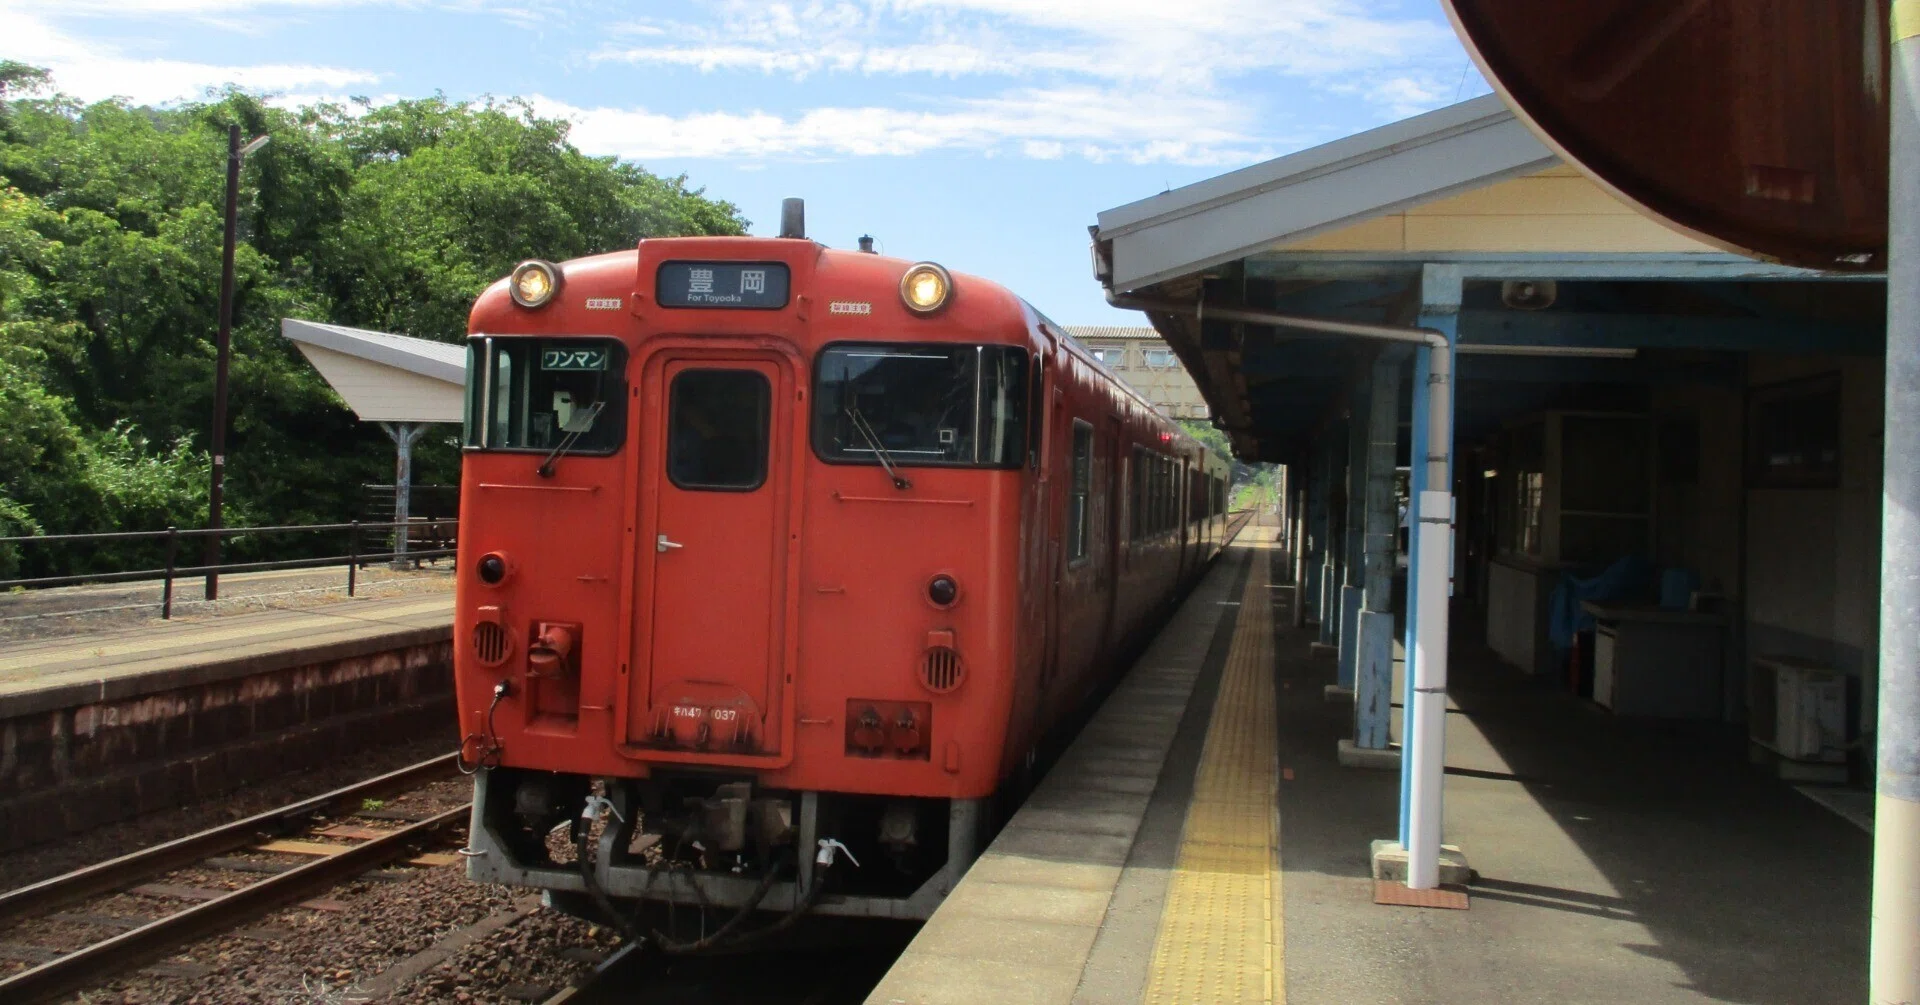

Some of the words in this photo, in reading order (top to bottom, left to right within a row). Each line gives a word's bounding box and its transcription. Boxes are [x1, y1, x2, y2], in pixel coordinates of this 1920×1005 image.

[687, 293, 702, 302] For
[704, 294, 742, 304] Toyooka
[545, 350, 605, 368] ワンマン
